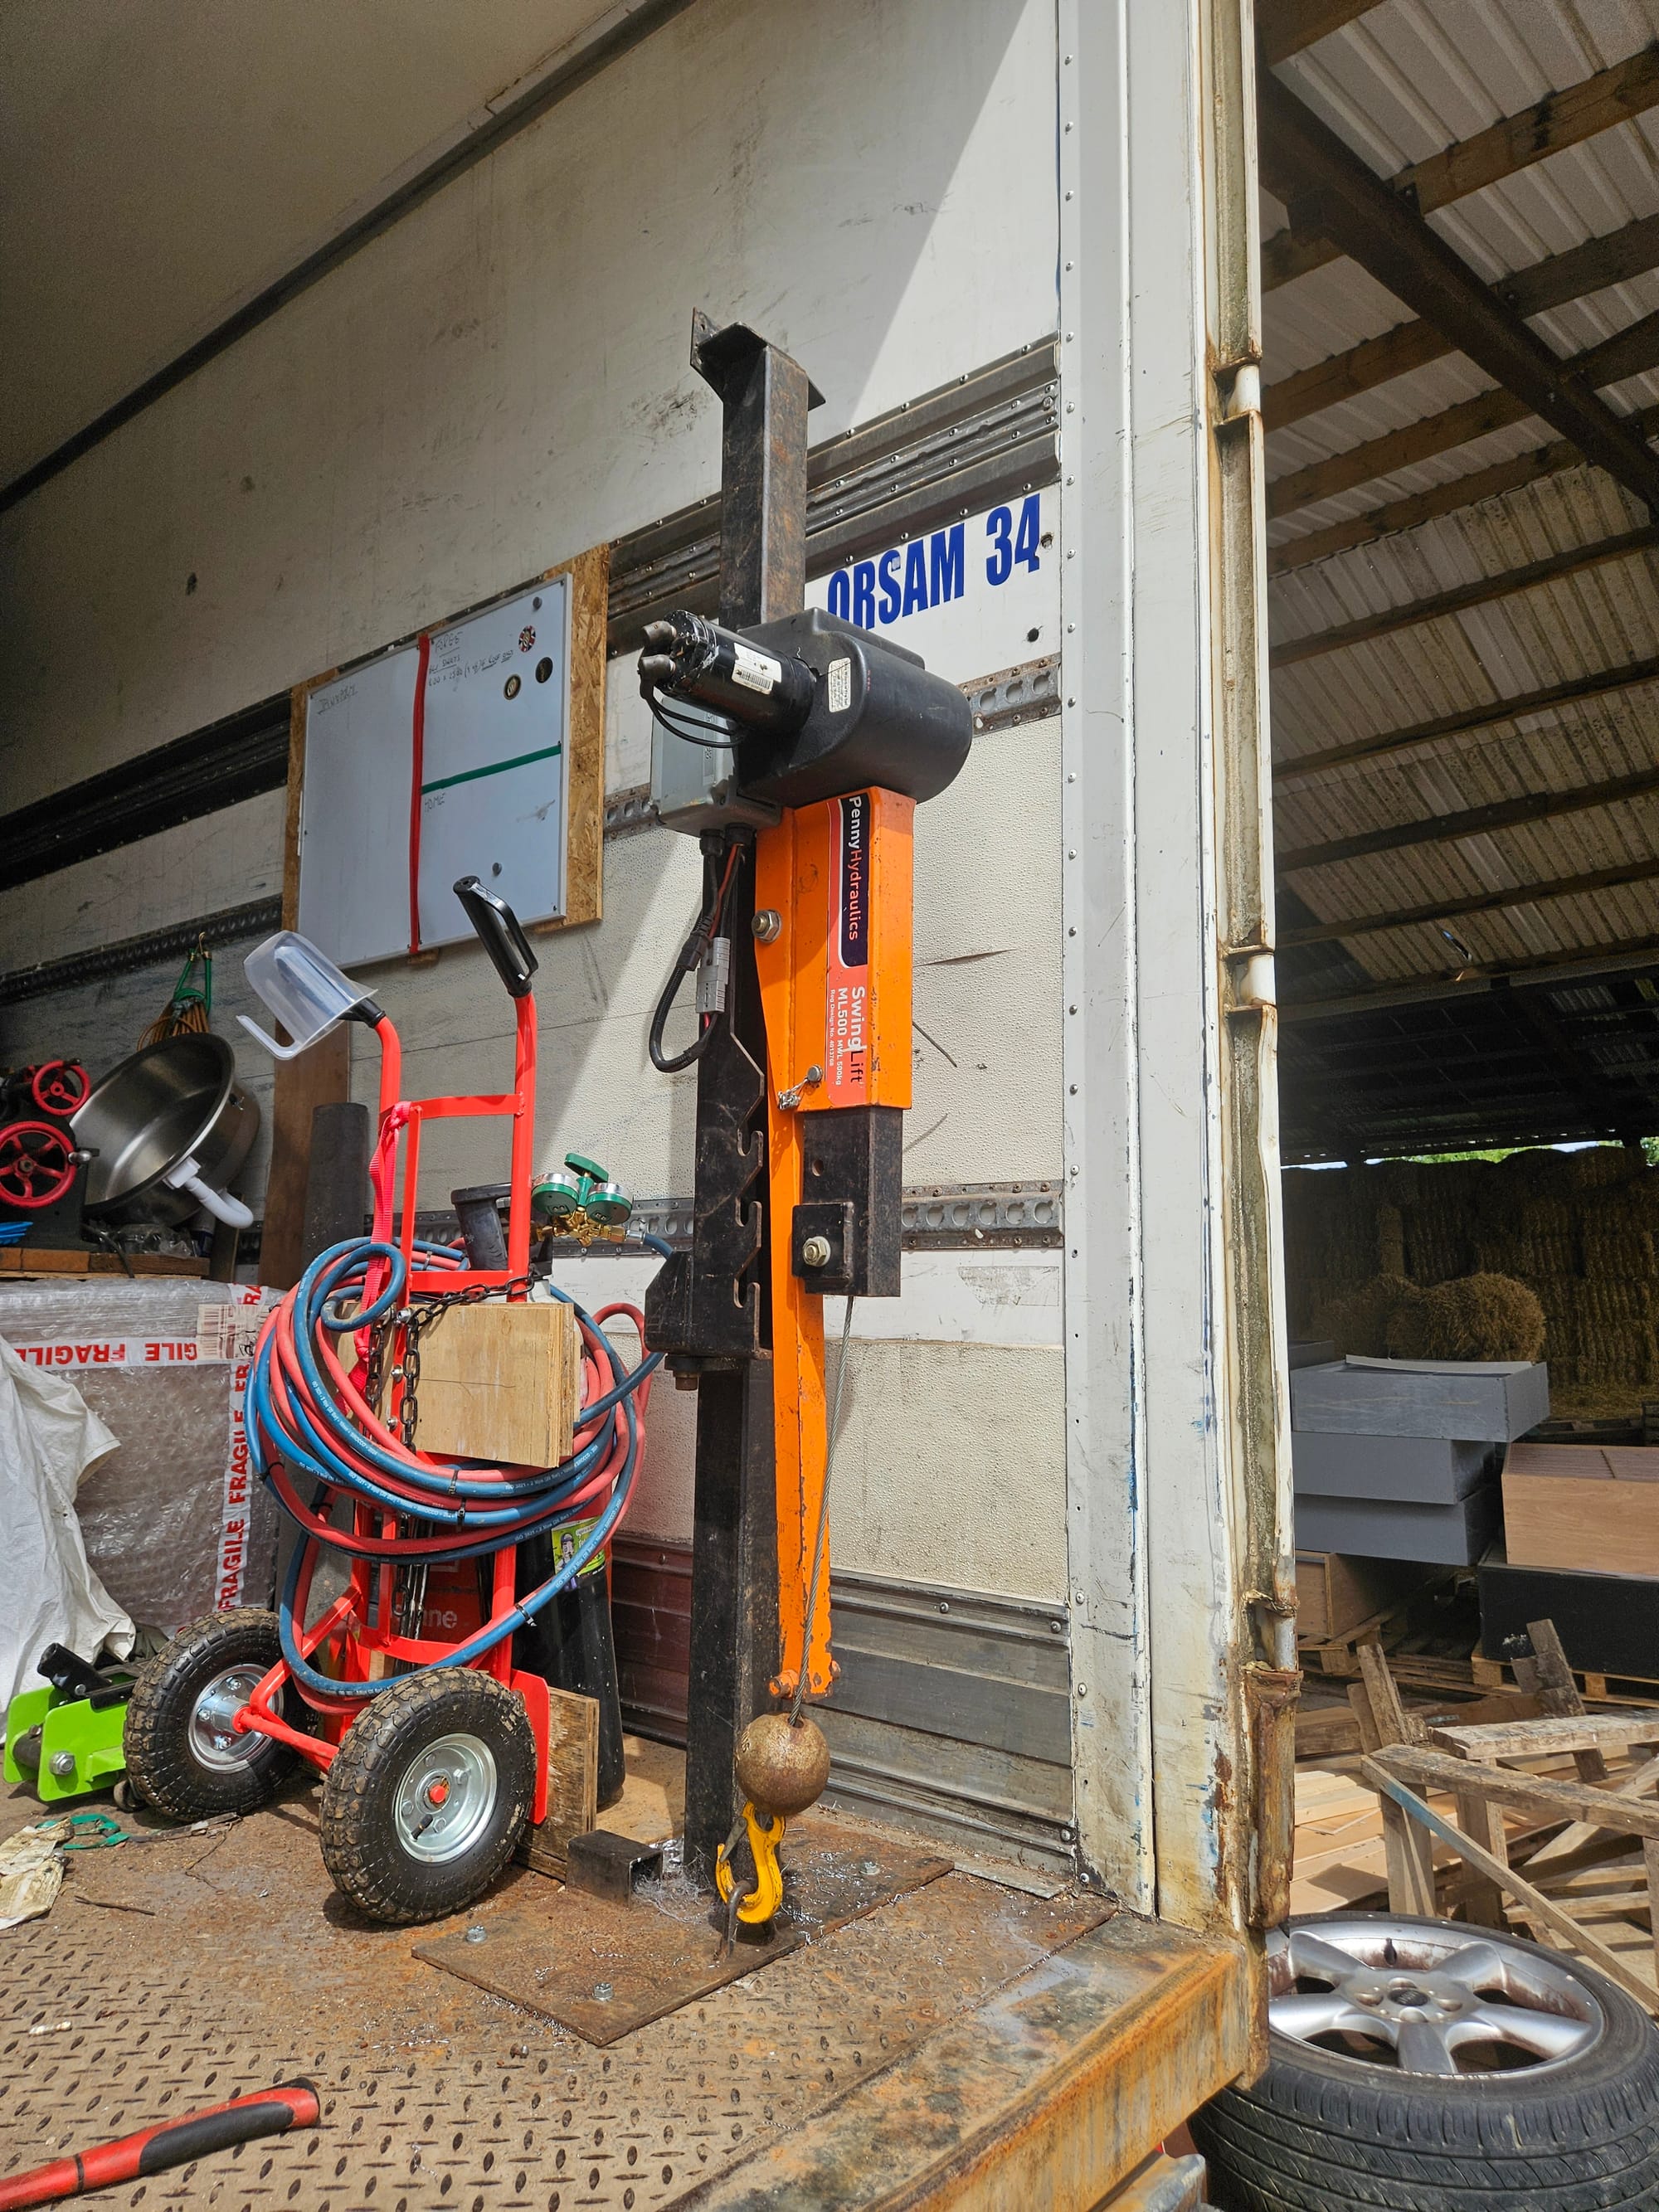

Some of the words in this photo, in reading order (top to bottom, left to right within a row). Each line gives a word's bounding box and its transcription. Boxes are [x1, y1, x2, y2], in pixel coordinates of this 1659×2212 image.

[828, 523, 965, 630] ORSAM
[985, 493, 1040, 586] 34
[848, 796, 864, 941] PennyHydraulics
[838, 987, 848, 1036] ML500
[218, 1519, 244, 1610] FRAGILE
